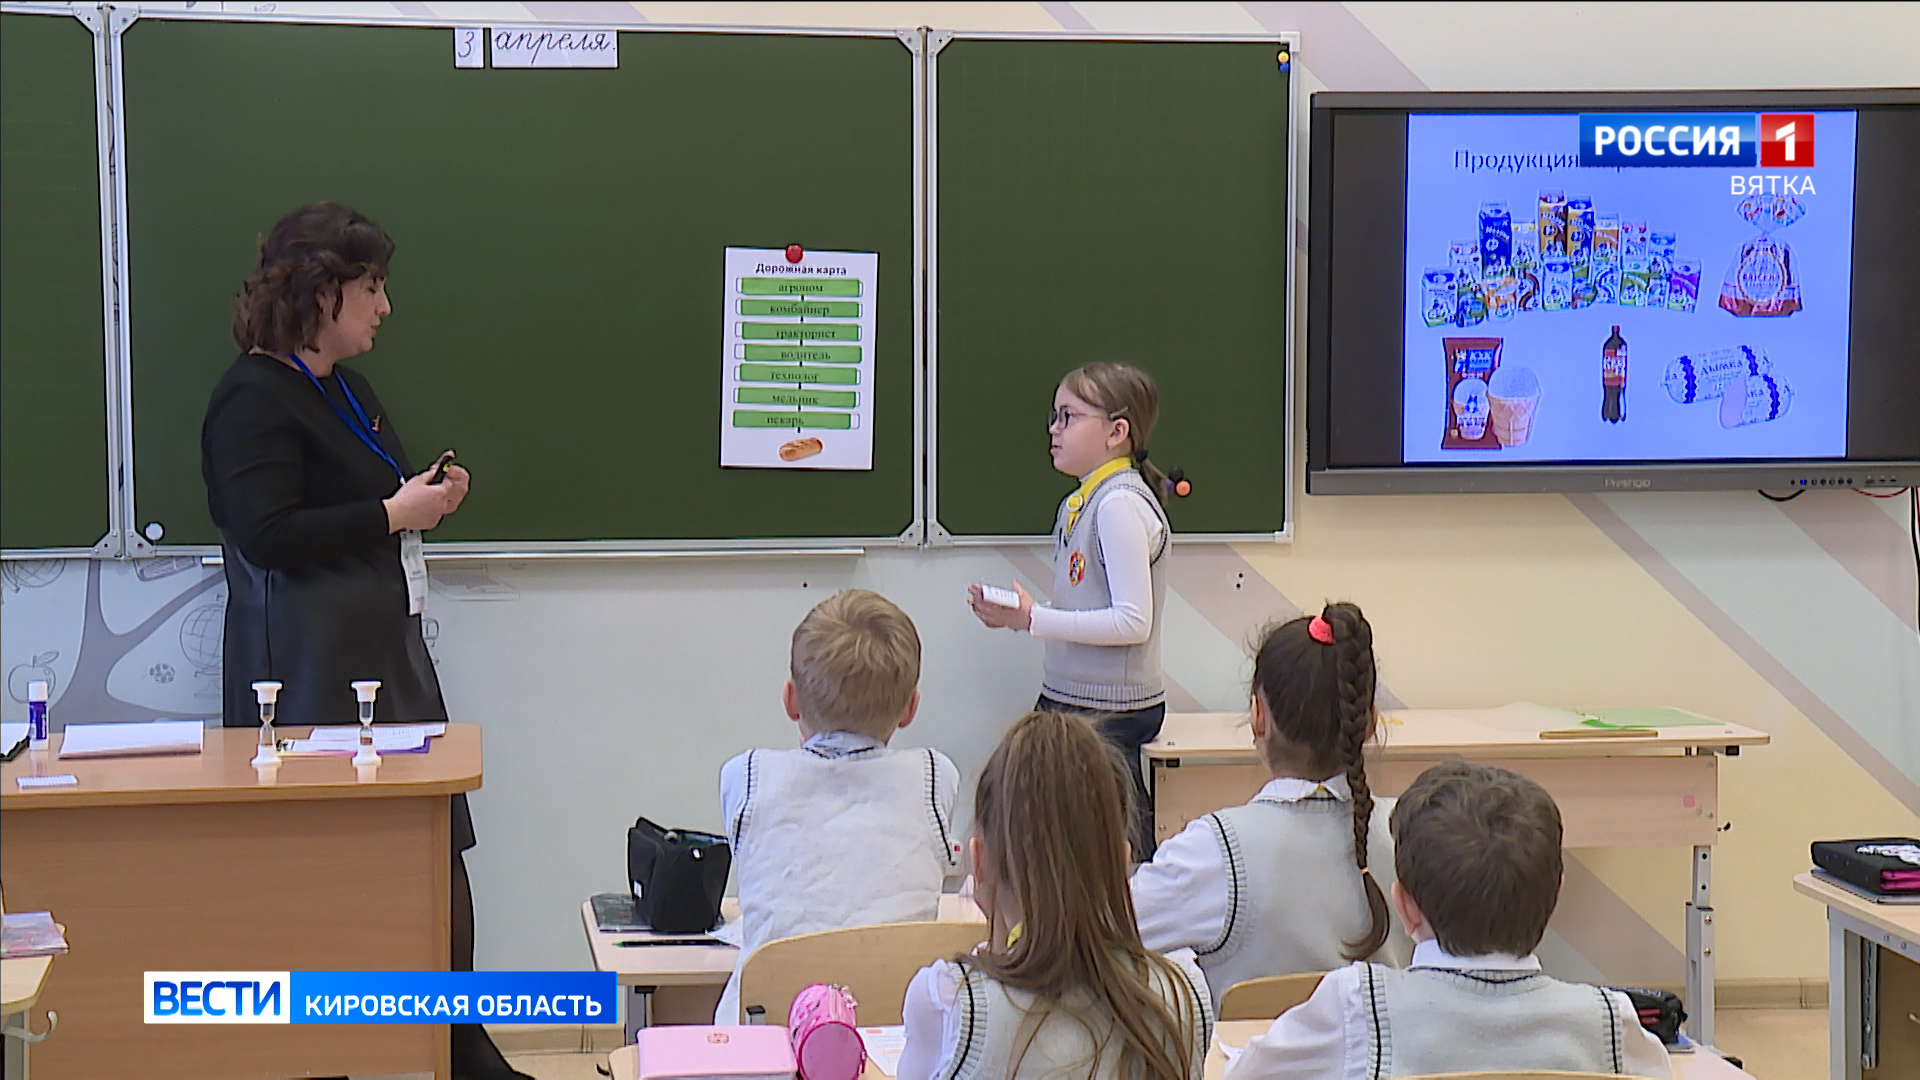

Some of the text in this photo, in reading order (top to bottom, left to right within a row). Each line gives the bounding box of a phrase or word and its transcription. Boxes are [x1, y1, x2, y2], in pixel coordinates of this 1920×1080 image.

[458, 31, 616, 65] 3 апреля.
[1454, 150, 1579, 174] Продукция
[755, 263, 847, 276] Дорожная карта
[779, 285, 823, 294] агроном
[776, 329, 836, 340] тракторист
[781, 351, 831, 361] водитель
[771, 372, 820, 382] технолог
[772, 395, 819, 405] мельник
[767, 417, 805, 428] пекарь
